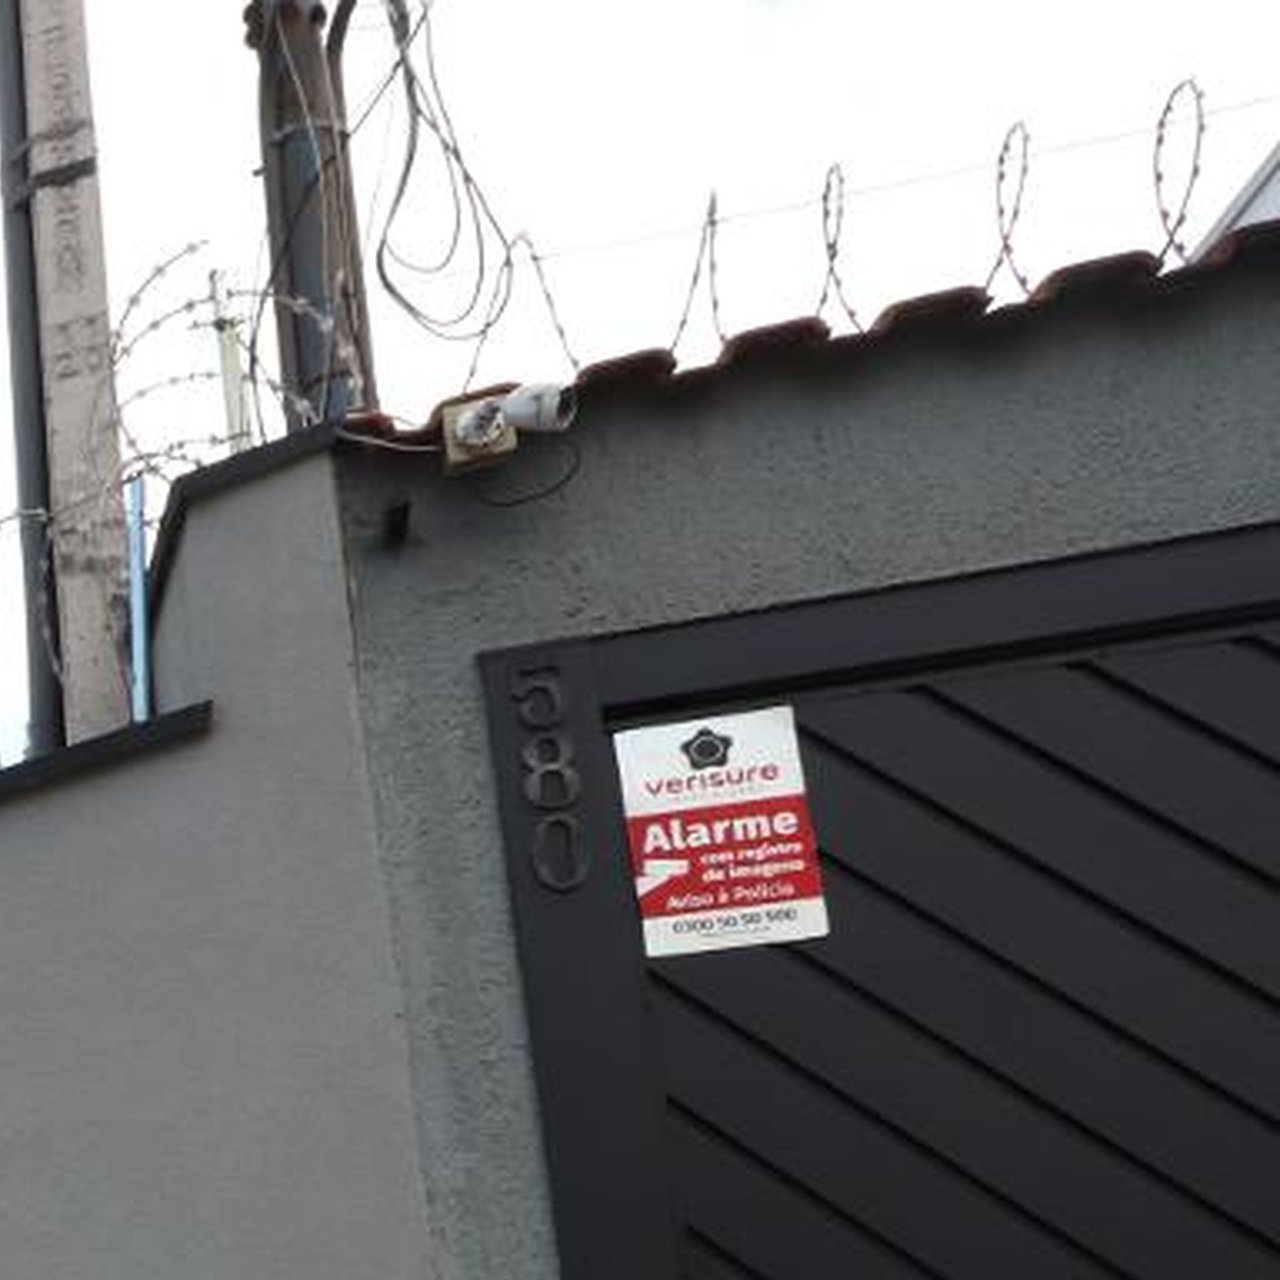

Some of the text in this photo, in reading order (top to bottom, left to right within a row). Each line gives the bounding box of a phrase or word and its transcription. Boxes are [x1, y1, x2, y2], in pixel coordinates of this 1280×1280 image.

[512, 665, 590, 893] 580
[644, 763, 780, 796] verisure
[642, 810, 799, 854] Alarme
